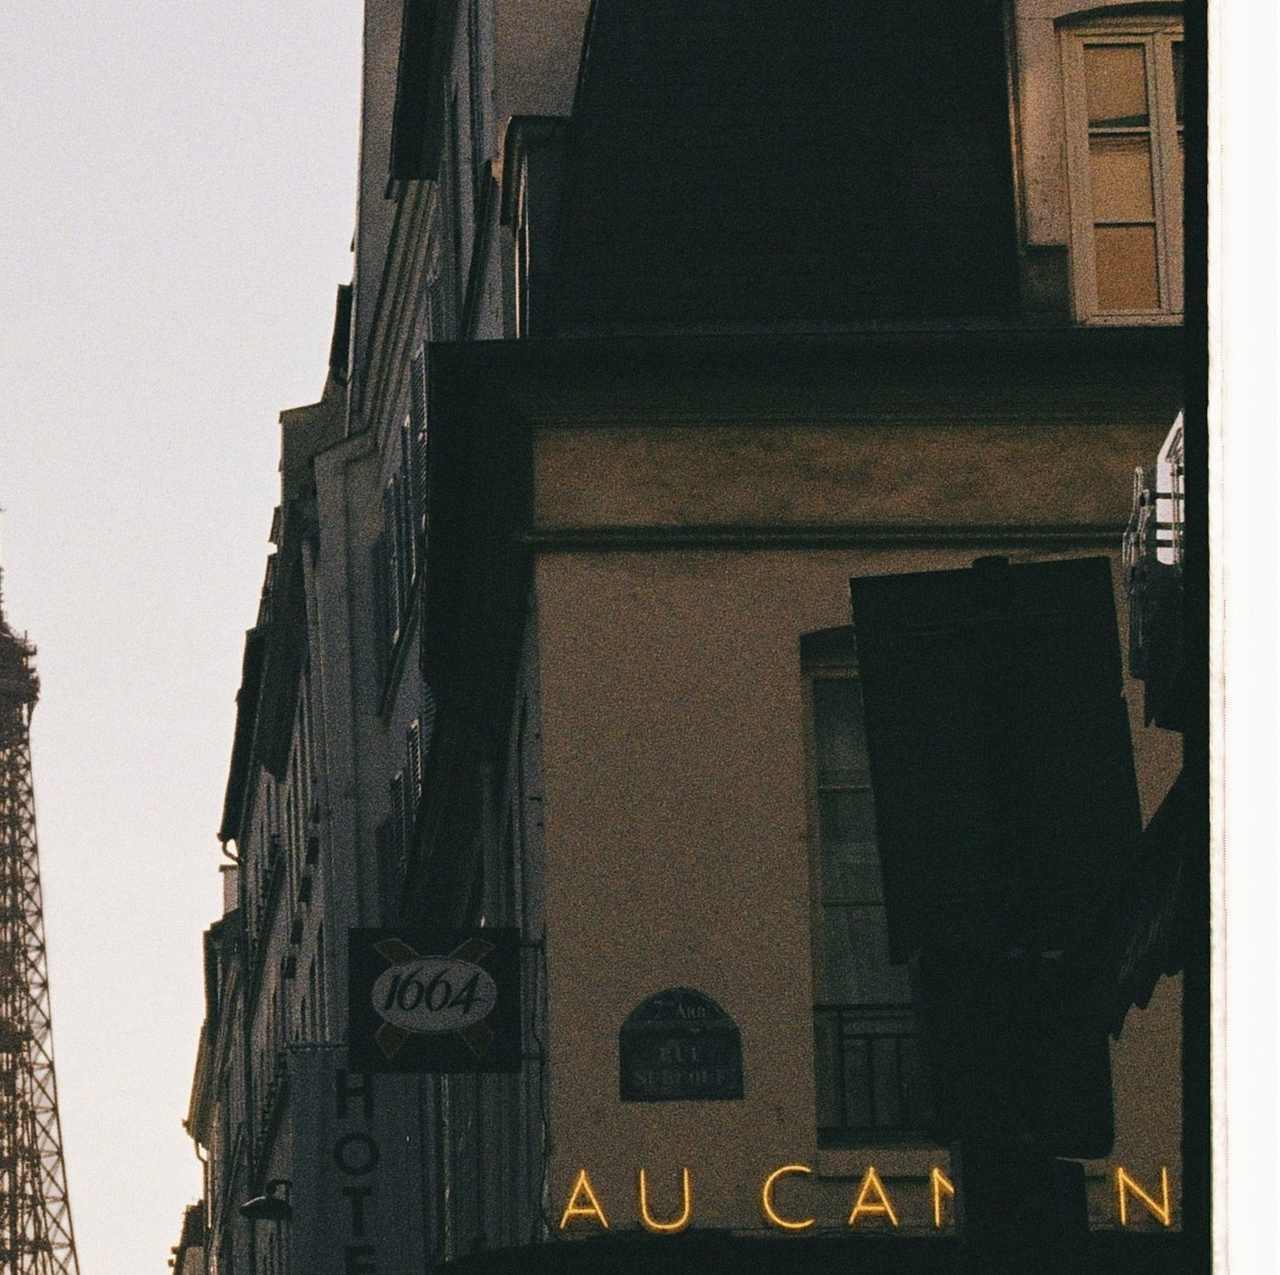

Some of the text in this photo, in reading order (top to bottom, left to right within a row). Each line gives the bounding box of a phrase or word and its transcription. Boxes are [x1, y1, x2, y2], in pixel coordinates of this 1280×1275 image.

[383, 966, 486, 1014] 1664
[559, 1164, 1170, 1232] AU CAN
